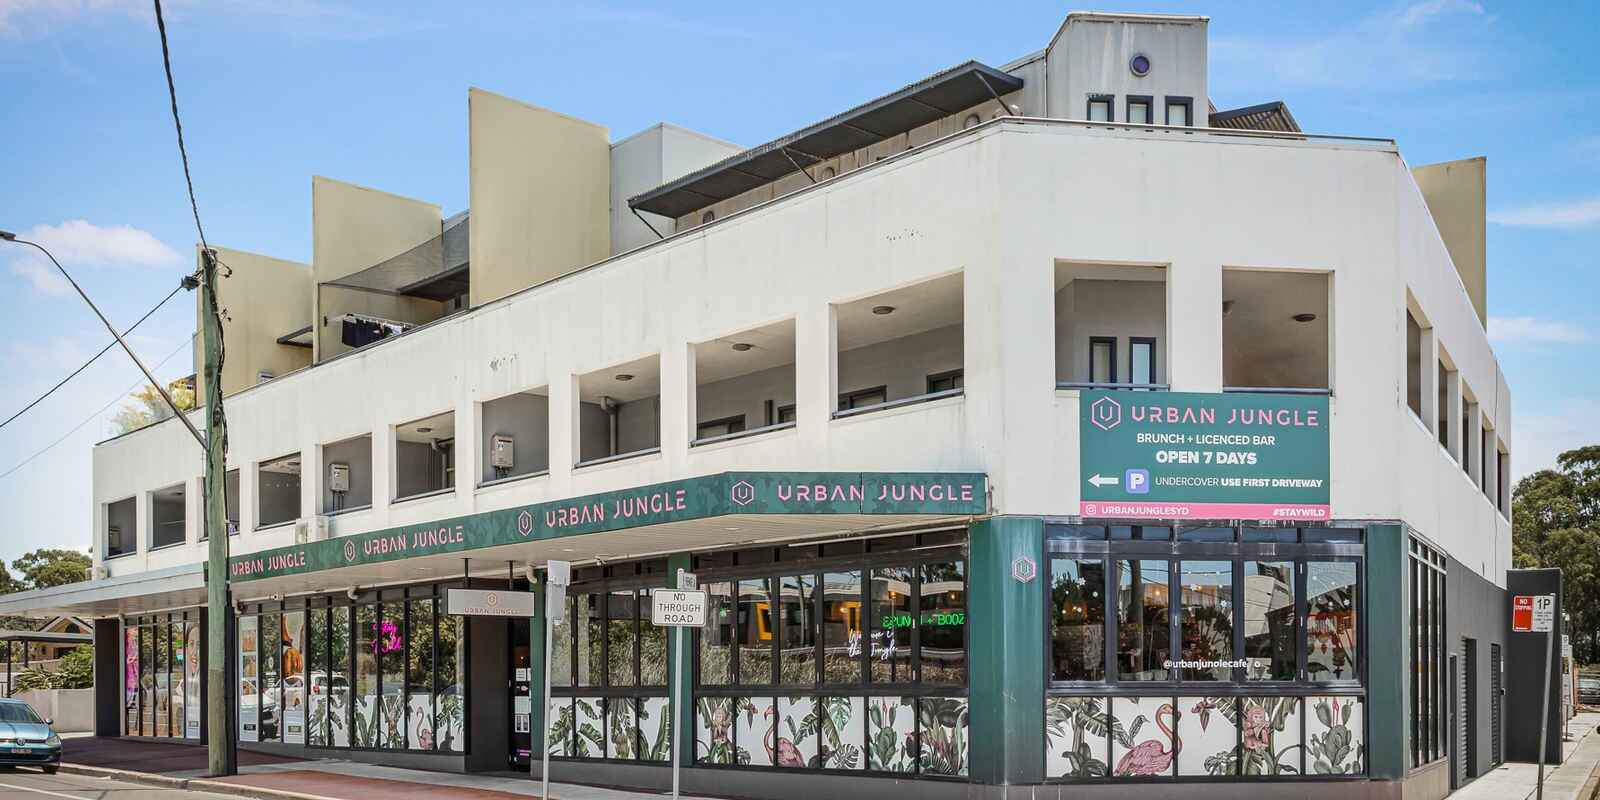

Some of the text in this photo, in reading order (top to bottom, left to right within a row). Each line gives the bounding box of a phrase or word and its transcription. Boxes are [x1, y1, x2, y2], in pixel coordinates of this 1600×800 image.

[1131, 406, 1215, 424] URBAN
[1227, 408, 1319, 426] JUNGLE
[1137, 433, 1184, 444] BRUNCH
[1196, 434, 1250, 445] LICENCED
[1253, 435, 1275, 446] BAR
[1156, 451, 1257, 465] OPEN 7 DAYS
[1130, 473, 1323, 490] P UNDERCOVER USE FIRST DRIVEWAY
[777, 485, 864, 502] URBAN
[878, 484, 973, 502] JUNGLE
[546, 503, 604, 528] URBAN
[613, 490, 687, 519] JUNGLE
[1101, 506, 1325, 517] URBANJUNGLESYD #STAYWILD
[363, 534, 406, 555] URBAN
[412, 525, 464, 549] JUNGLE
[232, 551, 306, 576] URBAN JUNGLE
[673, 593, 686, 601] NO
[659, 603, 701, 612] THROUGH
[1537, 598, 1552, 610] 1P
[664, 614, 694, 623] ROAD
[938, 613, 965, 626] BOOZ
